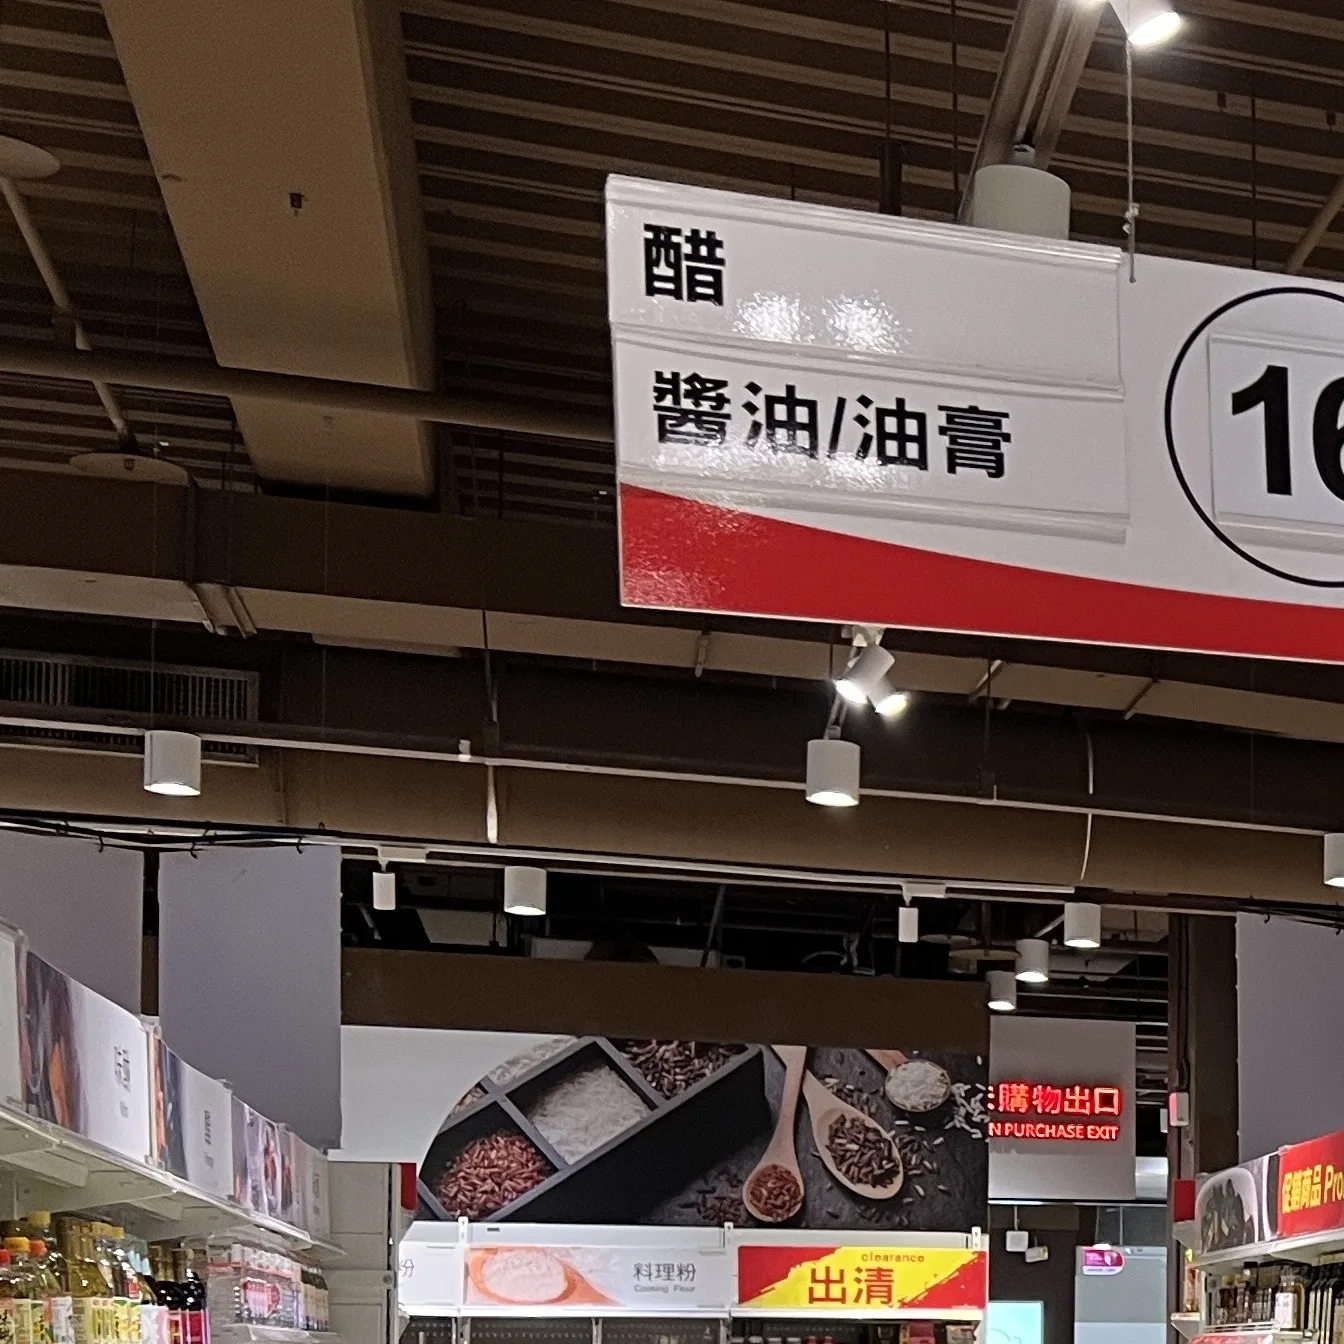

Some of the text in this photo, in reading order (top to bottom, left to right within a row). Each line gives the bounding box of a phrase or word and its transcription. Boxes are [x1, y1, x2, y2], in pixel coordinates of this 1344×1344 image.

[643, 222, 725, 308] 醋
[652, 370, 1013, 479] 醬油/油膏
[987, 1083, 1121, 1116] 購物出口
[1005, 1122, 1083, 1140] PURCHASE
[1087, 1124, 1119, 1140] EXIT
[1282, 1164, 1320, 1214] 促銷商品
[634, 1263, 696, 1282] 料理粉
[861, 1253, 925, 1263] clearance
[809, 1265, 894, 1305] 出清
